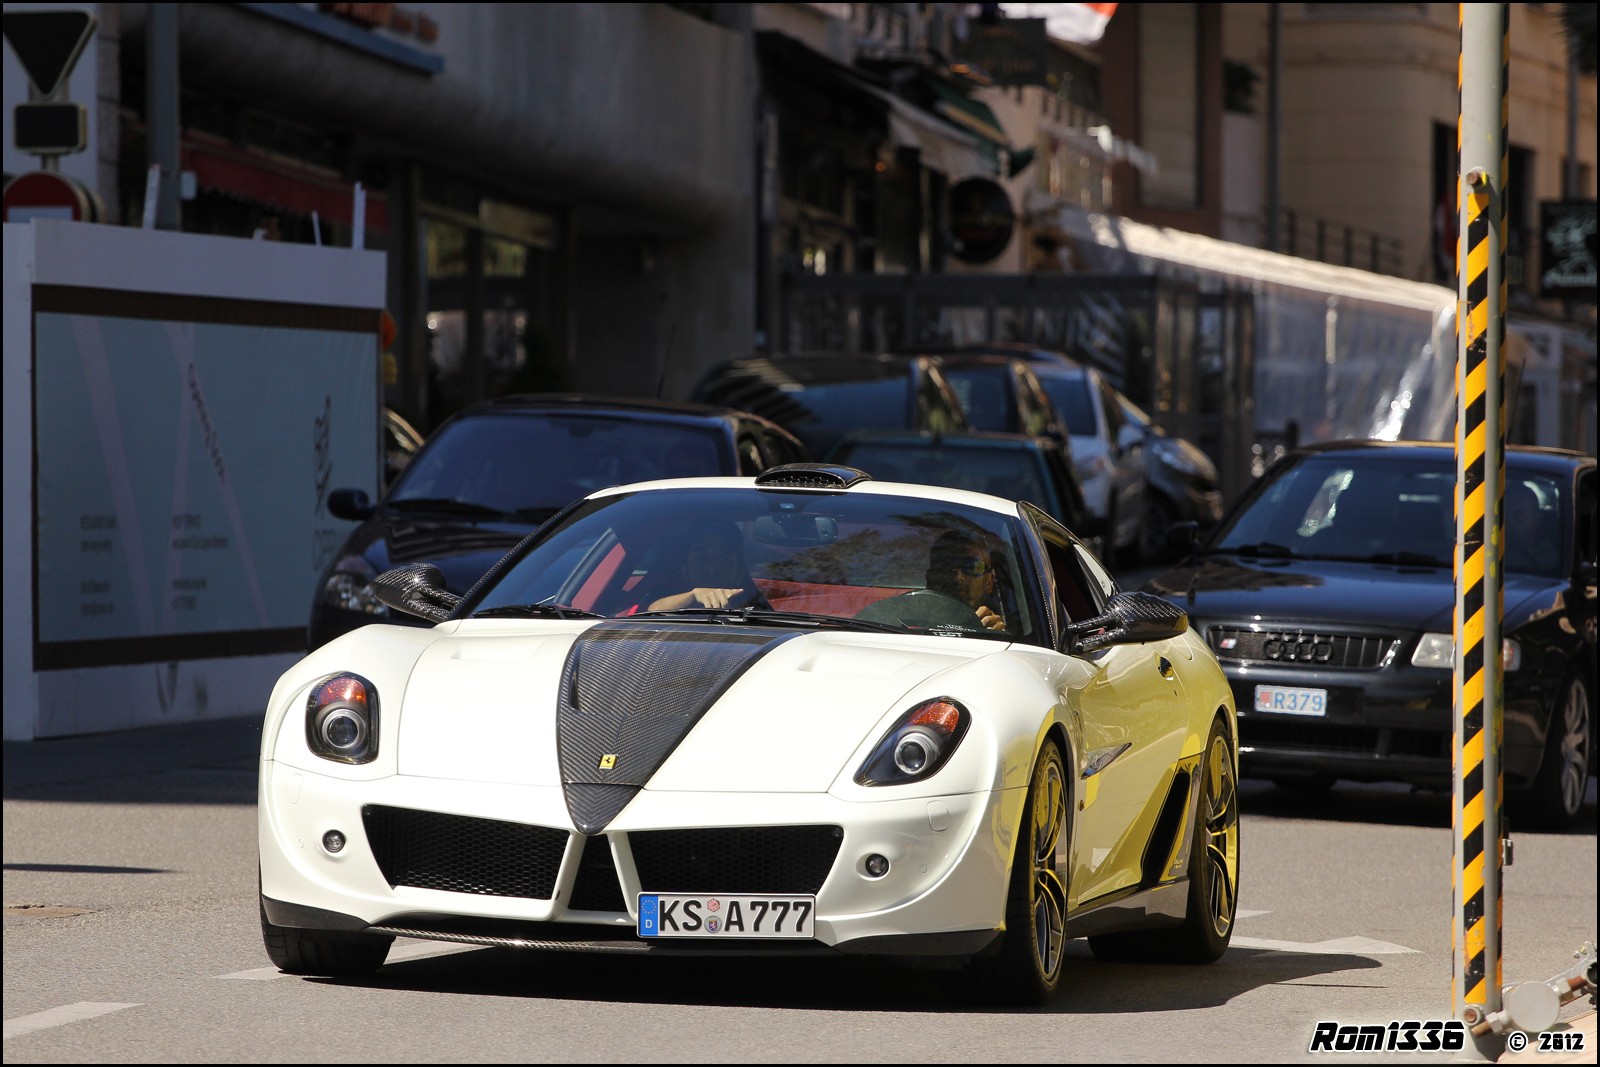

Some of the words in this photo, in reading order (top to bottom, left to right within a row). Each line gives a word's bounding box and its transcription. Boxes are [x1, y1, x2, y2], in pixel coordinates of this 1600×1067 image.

[1274, 691, 1323, 712] R379
[645, 919, 653, 929] D
[659, 900, 702, 932] KS
